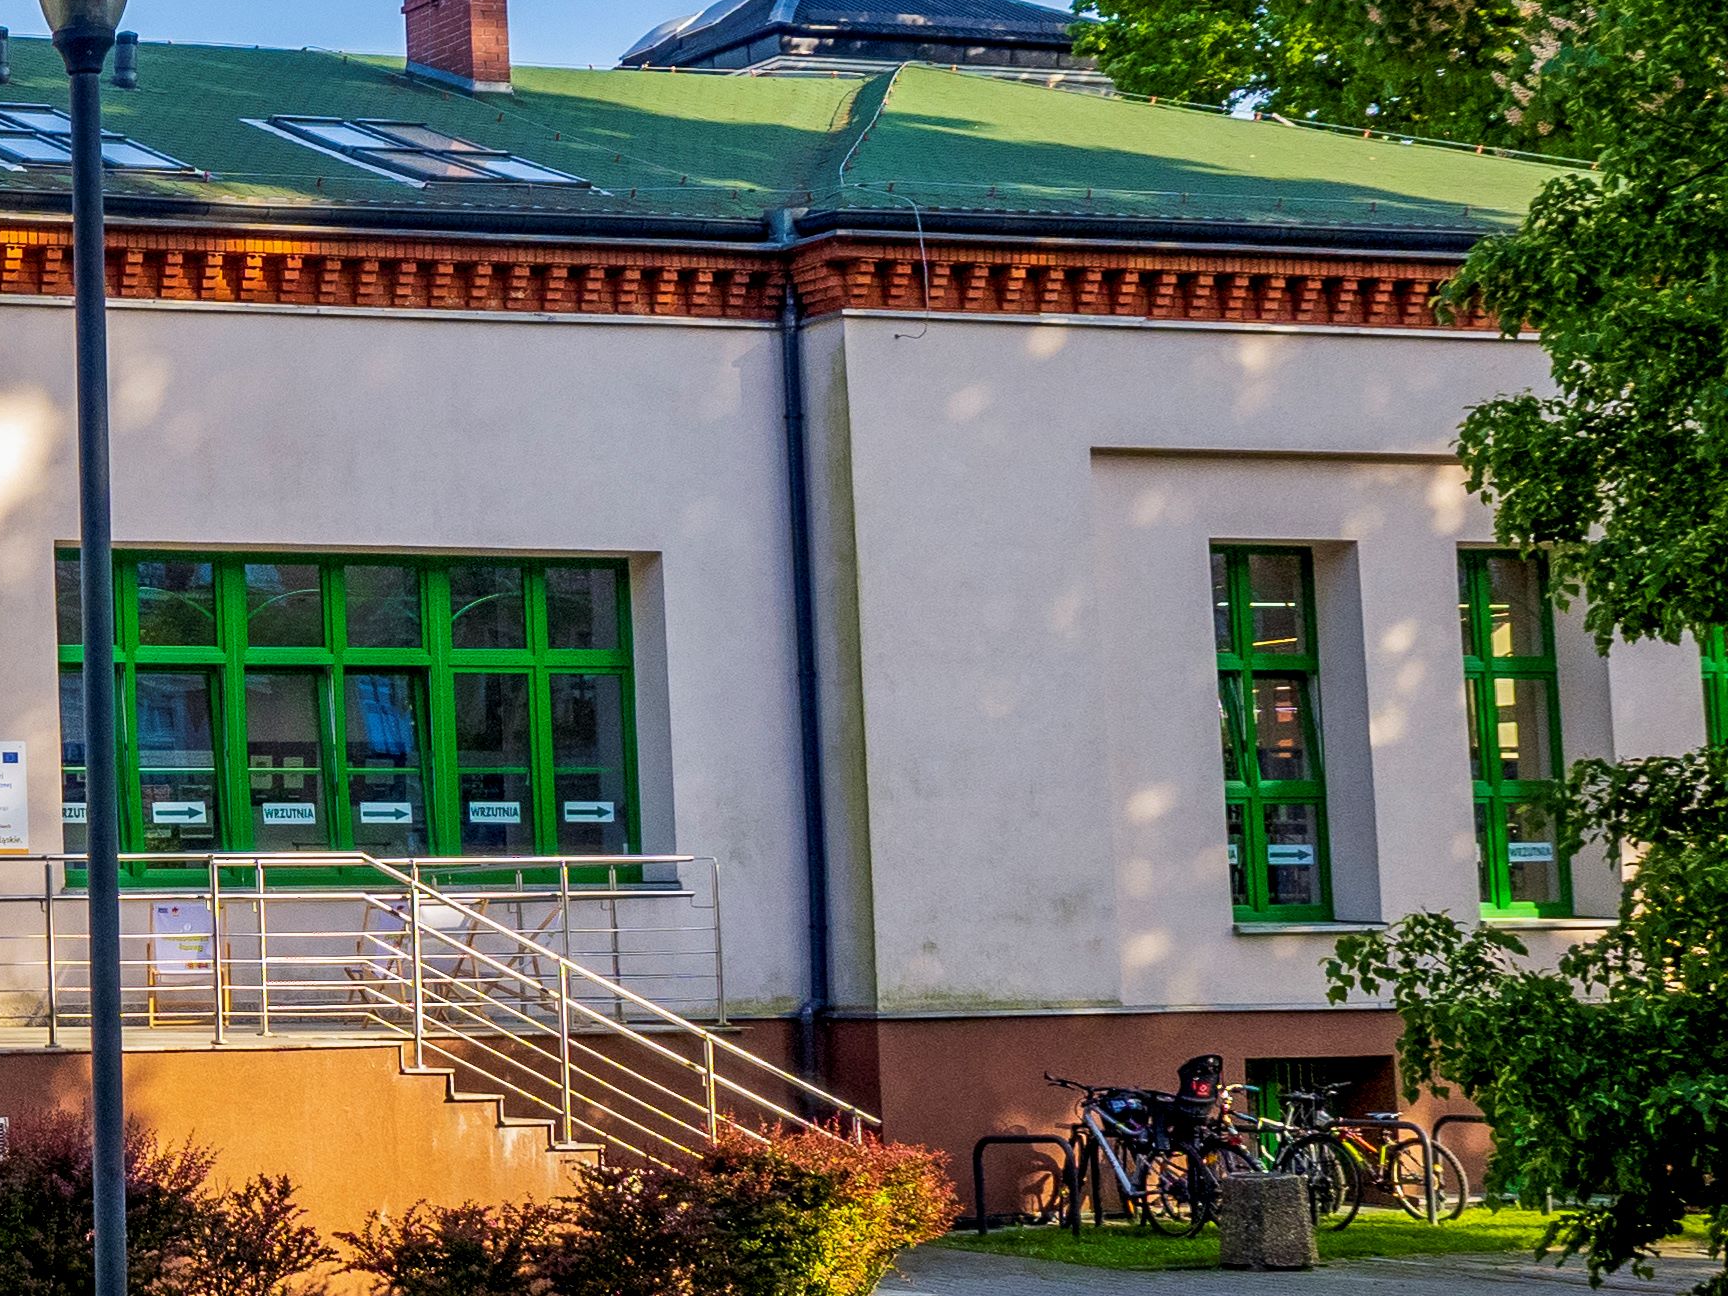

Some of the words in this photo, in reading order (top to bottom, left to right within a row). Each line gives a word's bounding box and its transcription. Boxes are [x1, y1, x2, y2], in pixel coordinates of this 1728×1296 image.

[62, 807, 86, 819] RZUT
[264, 808, 314, 819] WRZUTNIA
[470, 806, 519, 817] WRZUTNIA
